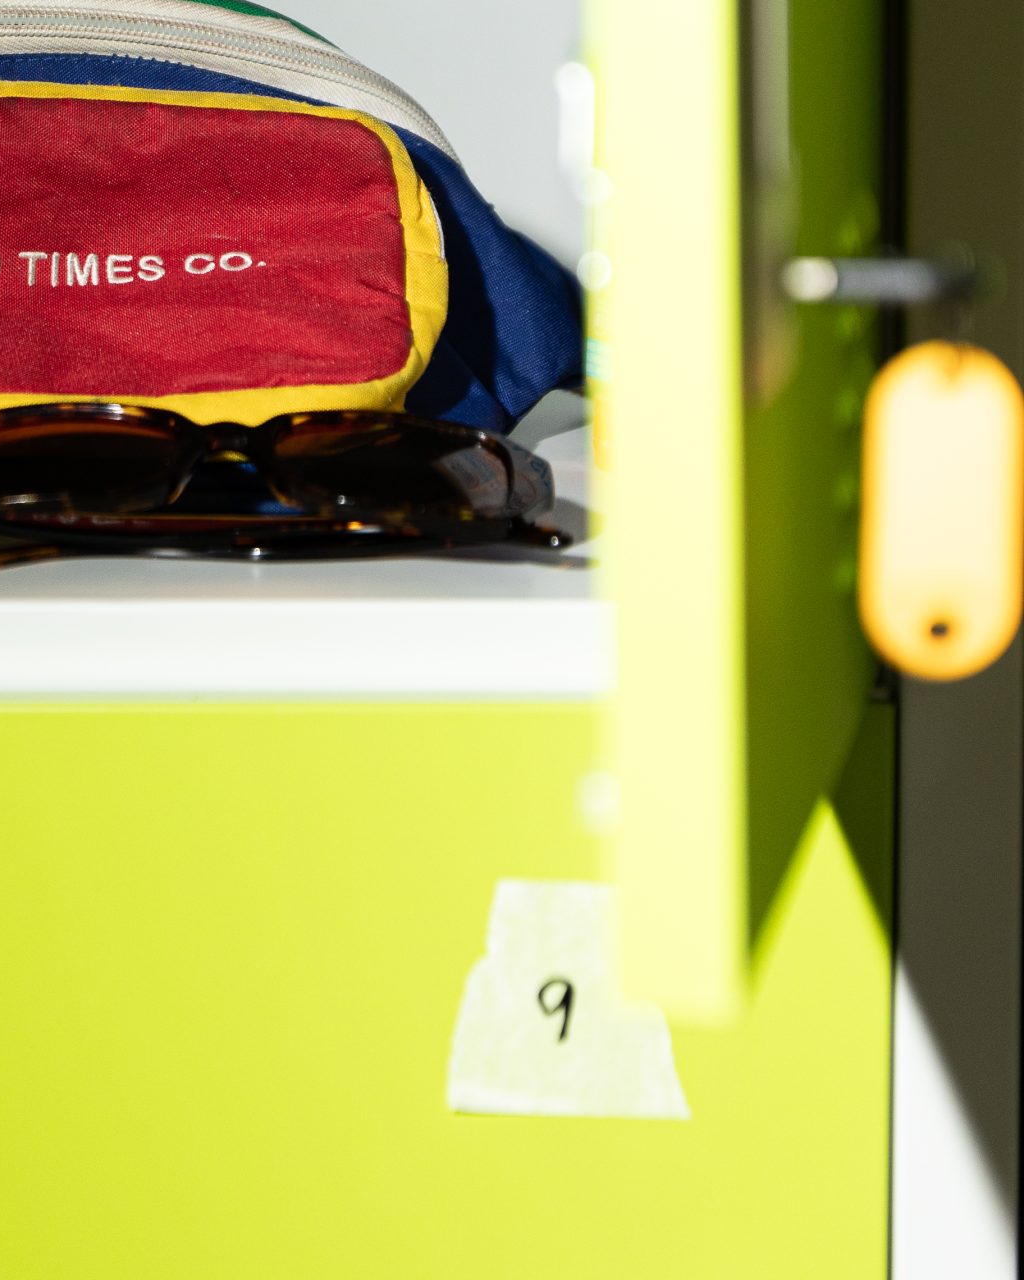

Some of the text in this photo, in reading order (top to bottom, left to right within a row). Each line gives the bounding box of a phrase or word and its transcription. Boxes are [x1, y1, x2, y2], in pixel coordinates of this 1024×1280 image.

[18, 251, 166, 287] TIMES
[184, 251, 267, 274] CO.
[536, 976, 575, 1043] 9
